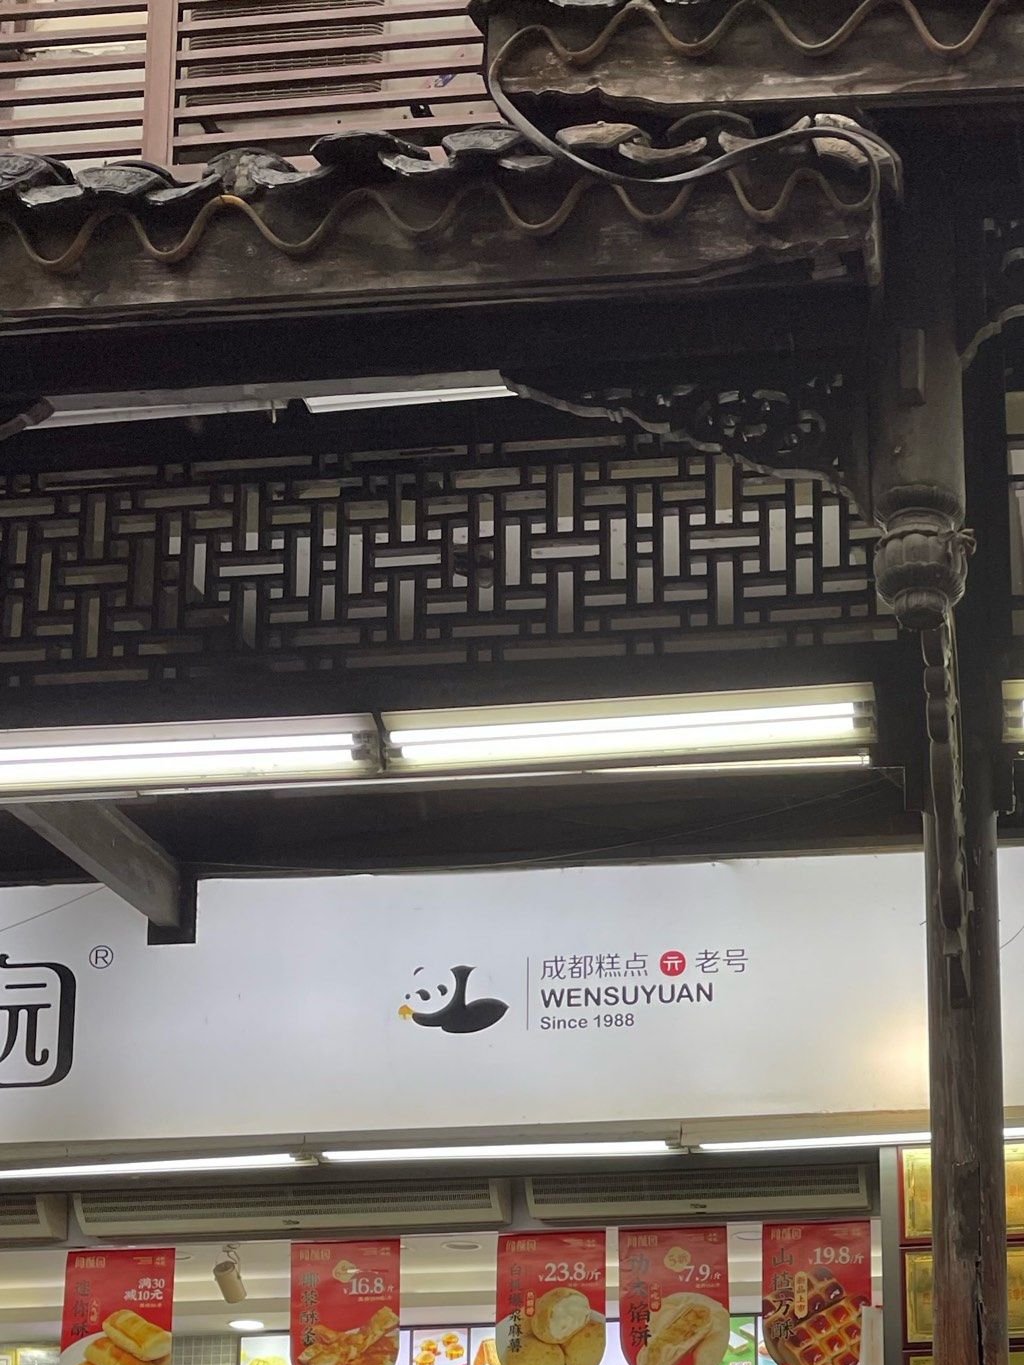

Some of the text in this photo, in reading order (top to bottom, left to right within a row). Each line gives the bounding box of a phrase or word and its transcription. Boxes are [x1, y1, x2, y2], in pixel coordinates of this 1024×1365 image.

[540, 982, 714, 1009] WENSUYUAN
[540, 1012, 635, 1031] Since 1988
